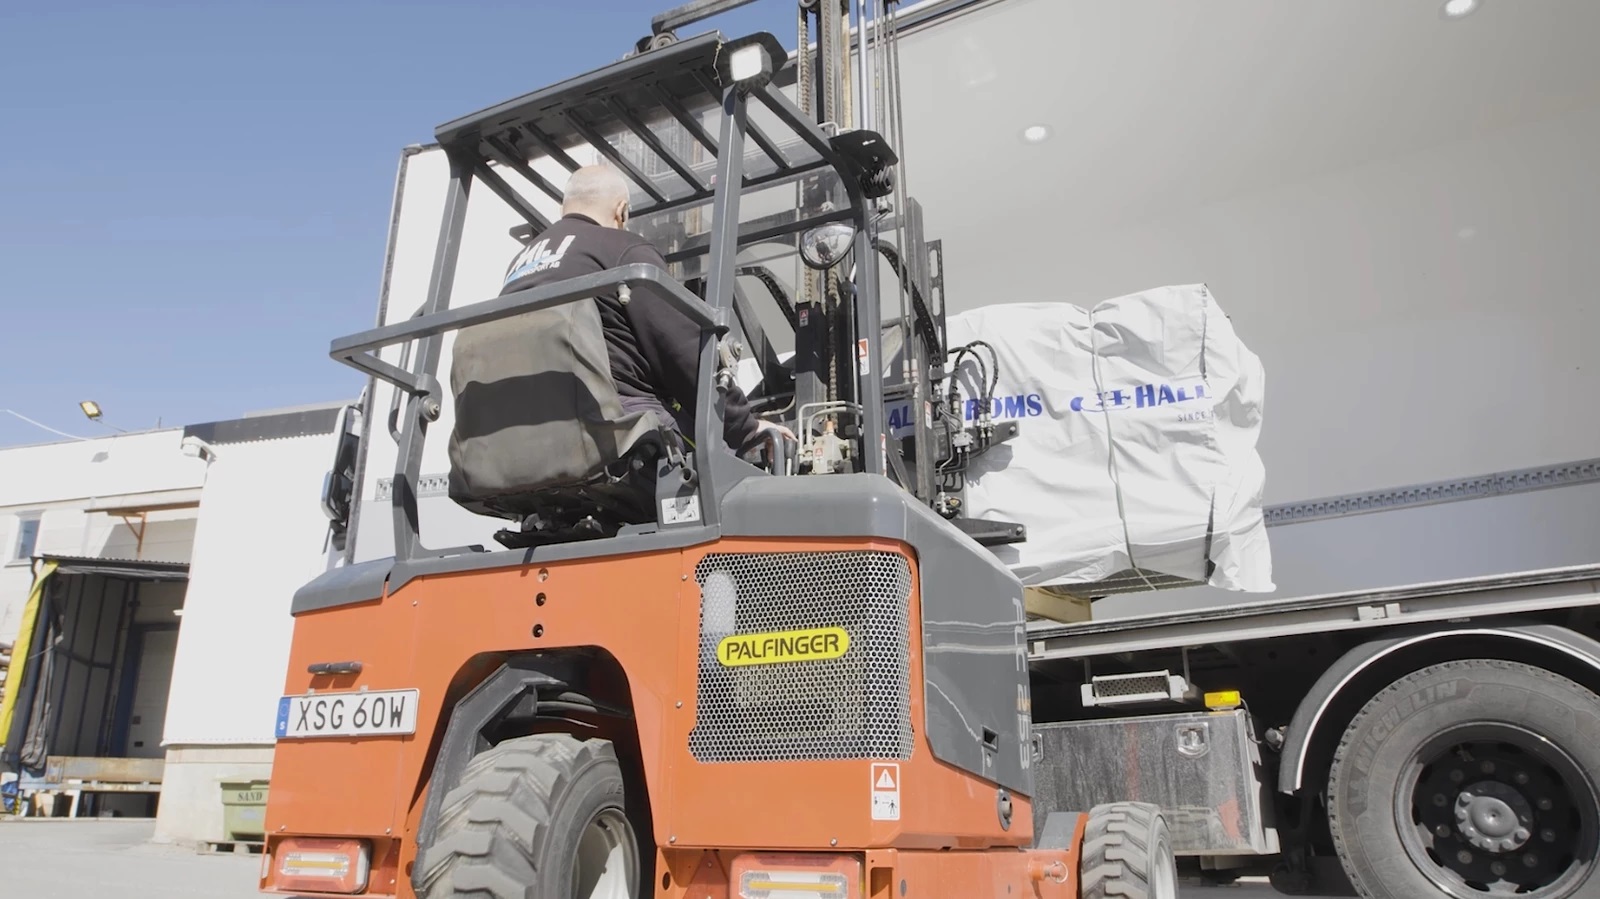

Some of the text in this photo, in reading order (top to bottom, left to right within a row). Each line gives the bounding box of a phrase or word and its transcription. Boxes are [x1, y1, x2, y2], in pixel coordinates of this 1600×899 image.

[1178, 411, 1206, 422] SINCE
[726, 633, 839, 660] PALFINGER
[296, 696, 406, 731] XSG 60W
[1017, 683, 1030, 770] 253
[1353, 680, 1458, 774] MICHELIN
[238, 792, 263, 802] SAND
